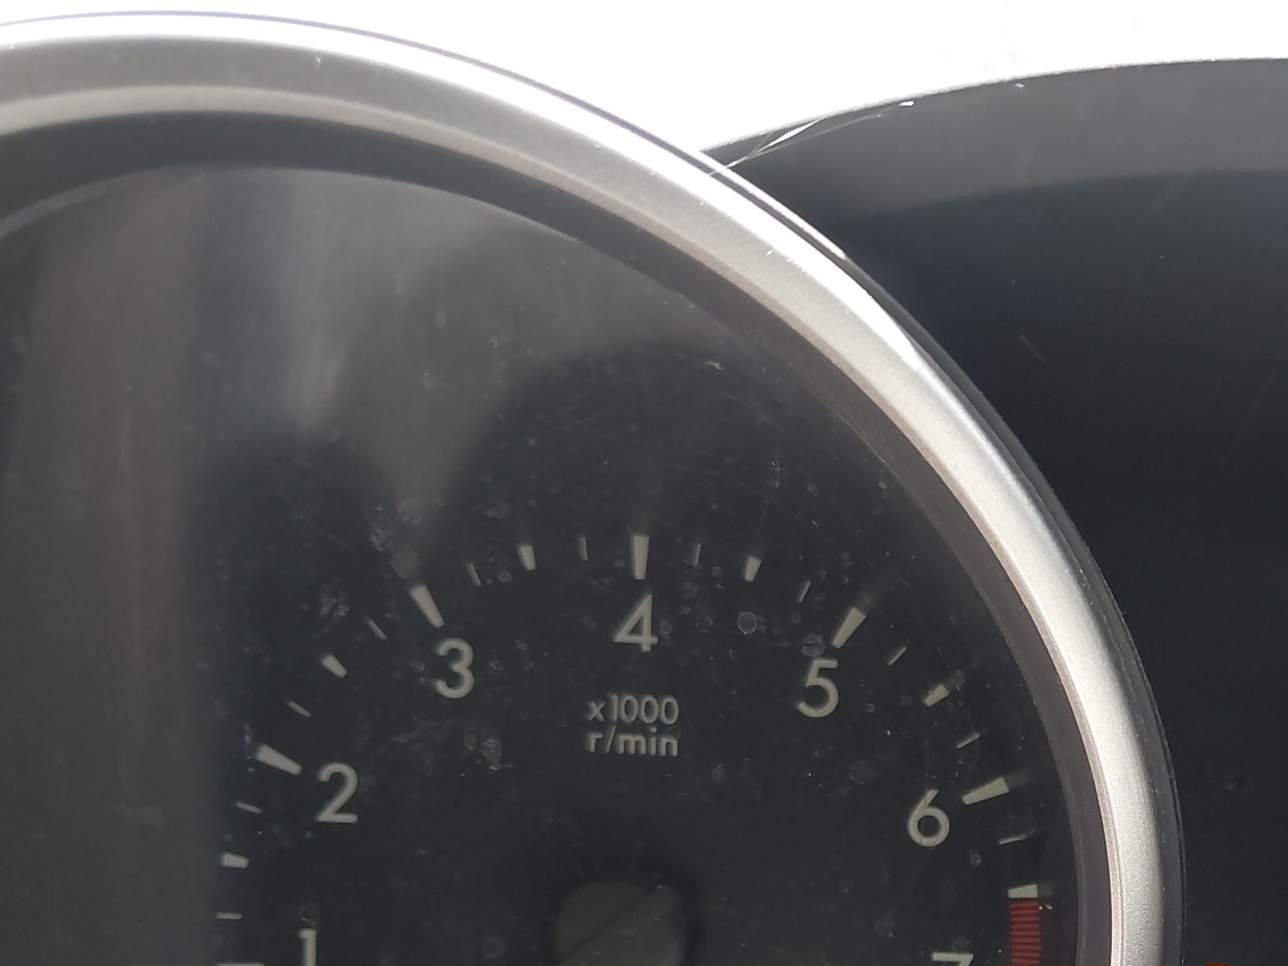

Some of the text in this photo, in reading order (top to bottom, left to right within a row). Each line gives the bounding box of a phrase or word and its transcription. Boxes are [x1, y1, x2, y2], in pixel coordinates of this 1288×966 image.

[615, 595, 657, 652] 4
[435, 638, 474, 698] 3
[799, 659, 839, 717] 5
[588, 695, 680, 725] x1000
[588, 727, 680, 757] r/min
[316, 763, 358, 823] 2
[906, 789, 950, 847] 6
